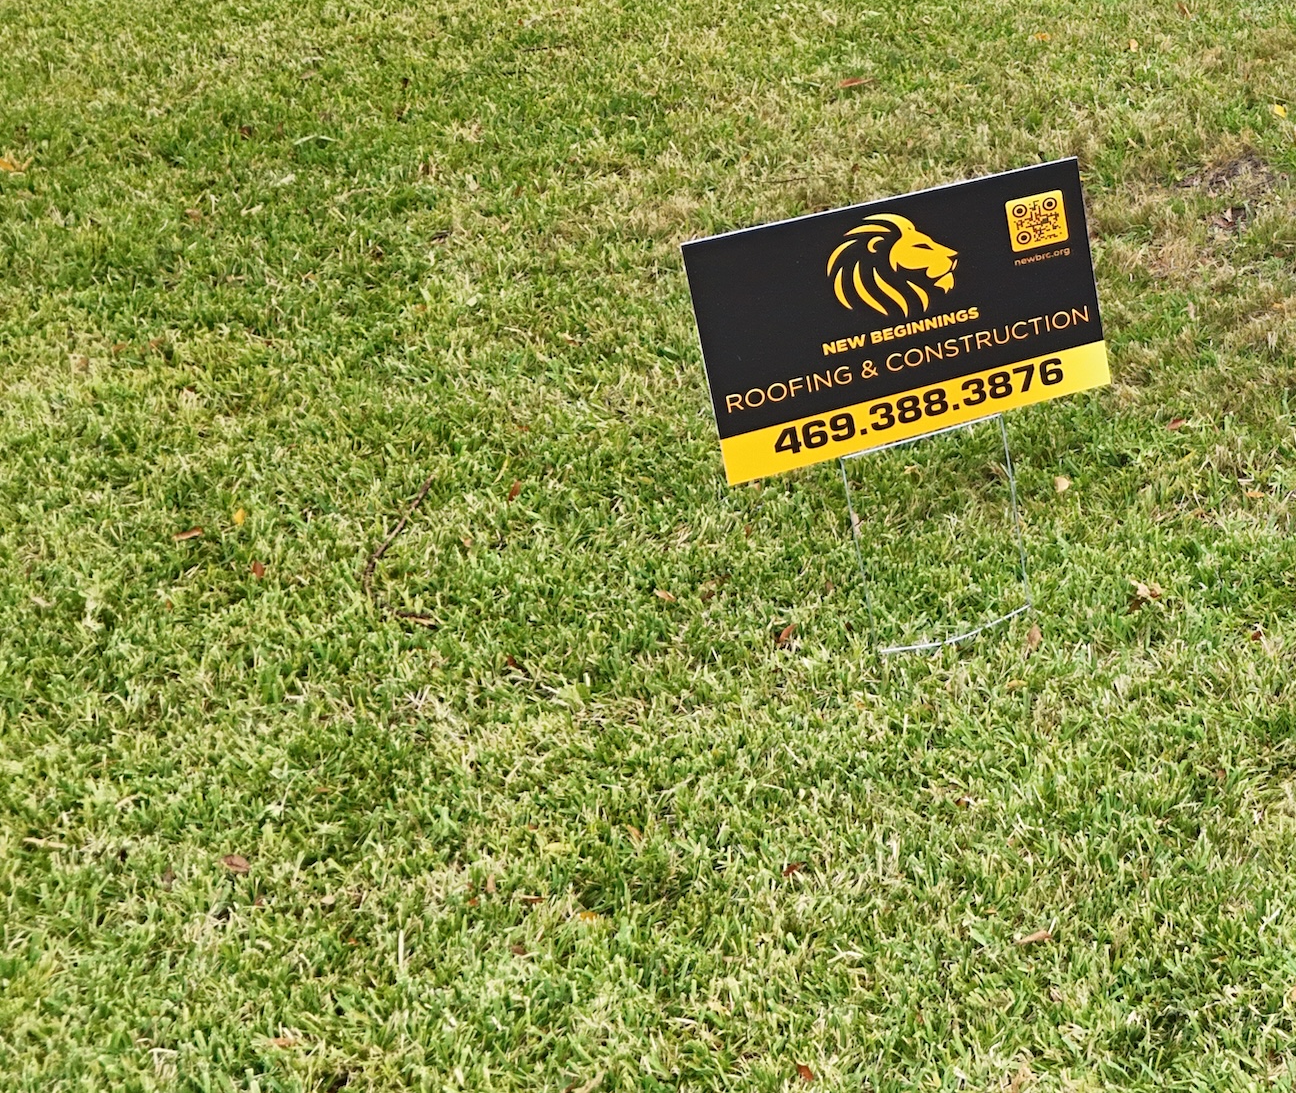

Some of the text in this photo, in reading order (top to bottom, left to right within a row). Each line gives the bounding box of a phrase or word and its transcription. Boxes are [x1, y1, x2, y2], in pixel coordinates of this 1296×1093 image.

[1014, 247, 1071, 266] newbrc.org
[726, 305, 1090, 414] ROOFING & CONSTRUCTION
[822, 307, 979, 356] NEW BEGINNINGS
[774, 357, 1064, 455] 469.388.3876
